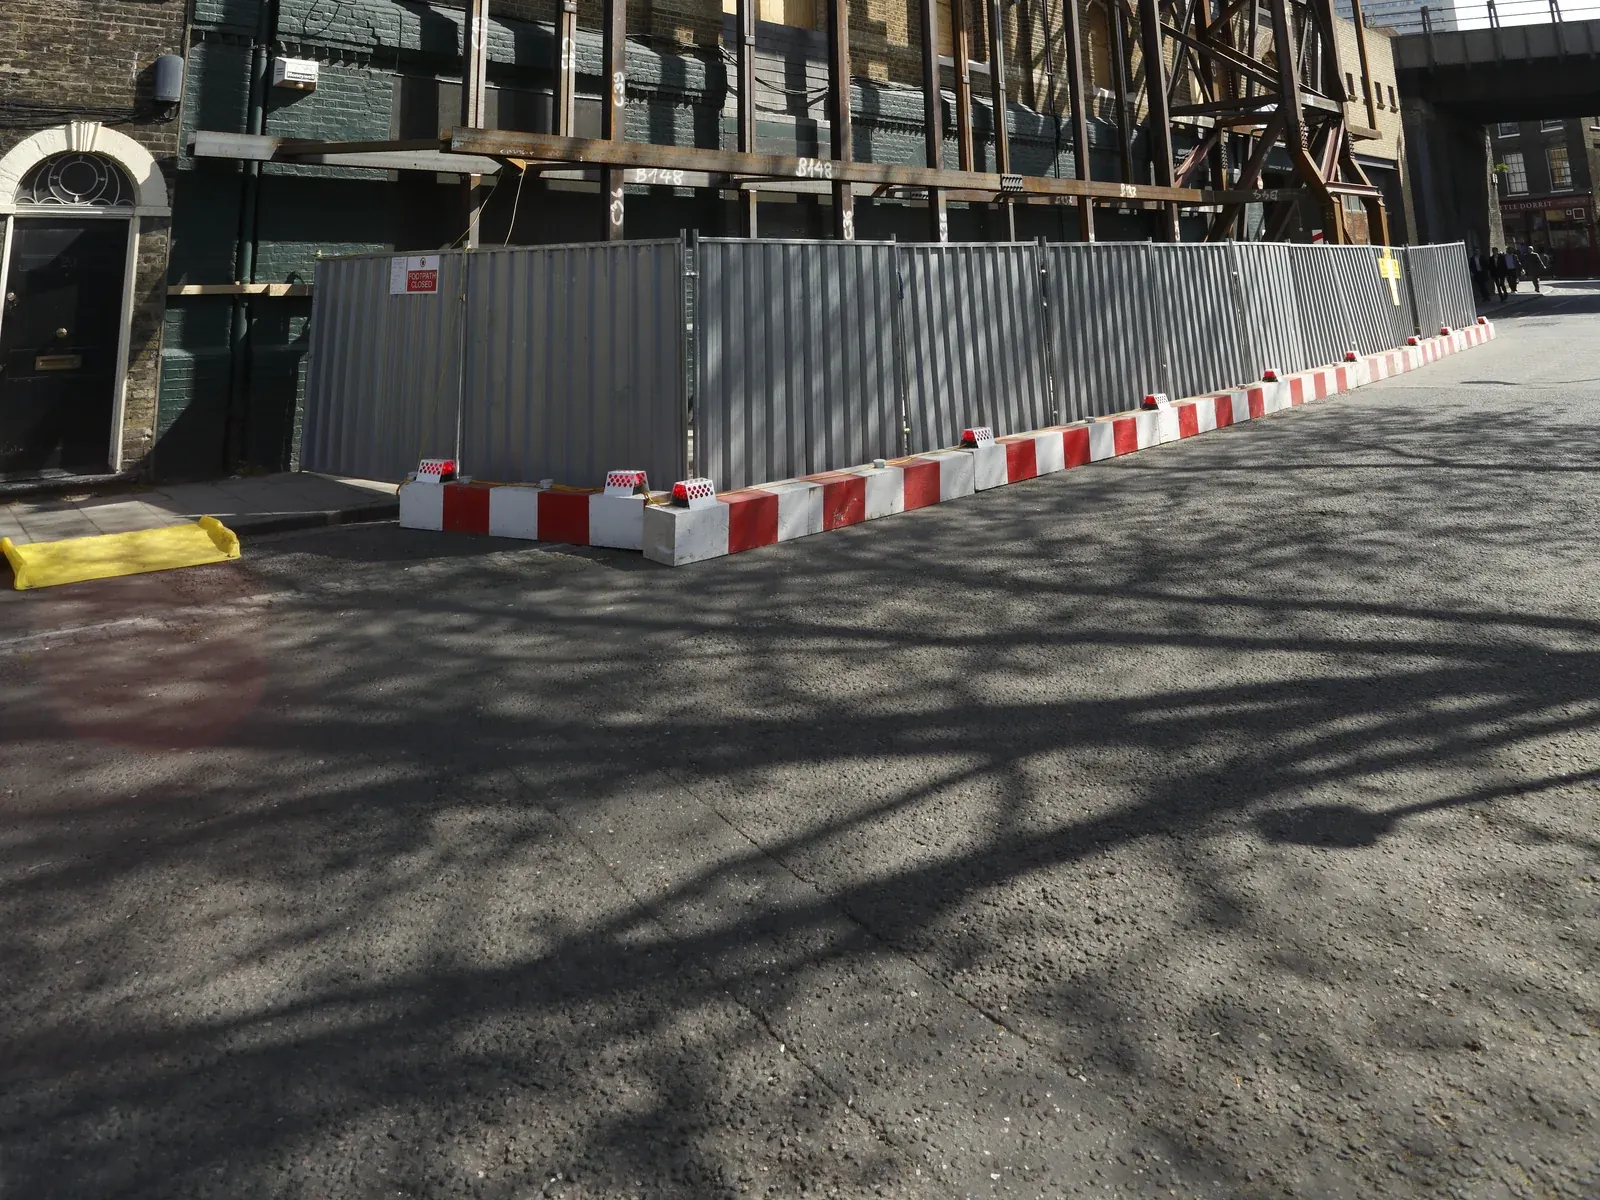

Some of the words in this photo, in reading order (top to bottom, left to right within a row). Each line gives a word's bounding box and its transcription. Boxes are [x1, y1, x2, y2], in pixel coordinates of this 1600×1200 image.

[795, 157, 833, 179] B148
[634, 167, 684, 186] B148
[408, 272, 437, 281] FOOTPATH
[410, 280, 433, 289] CLOSED
